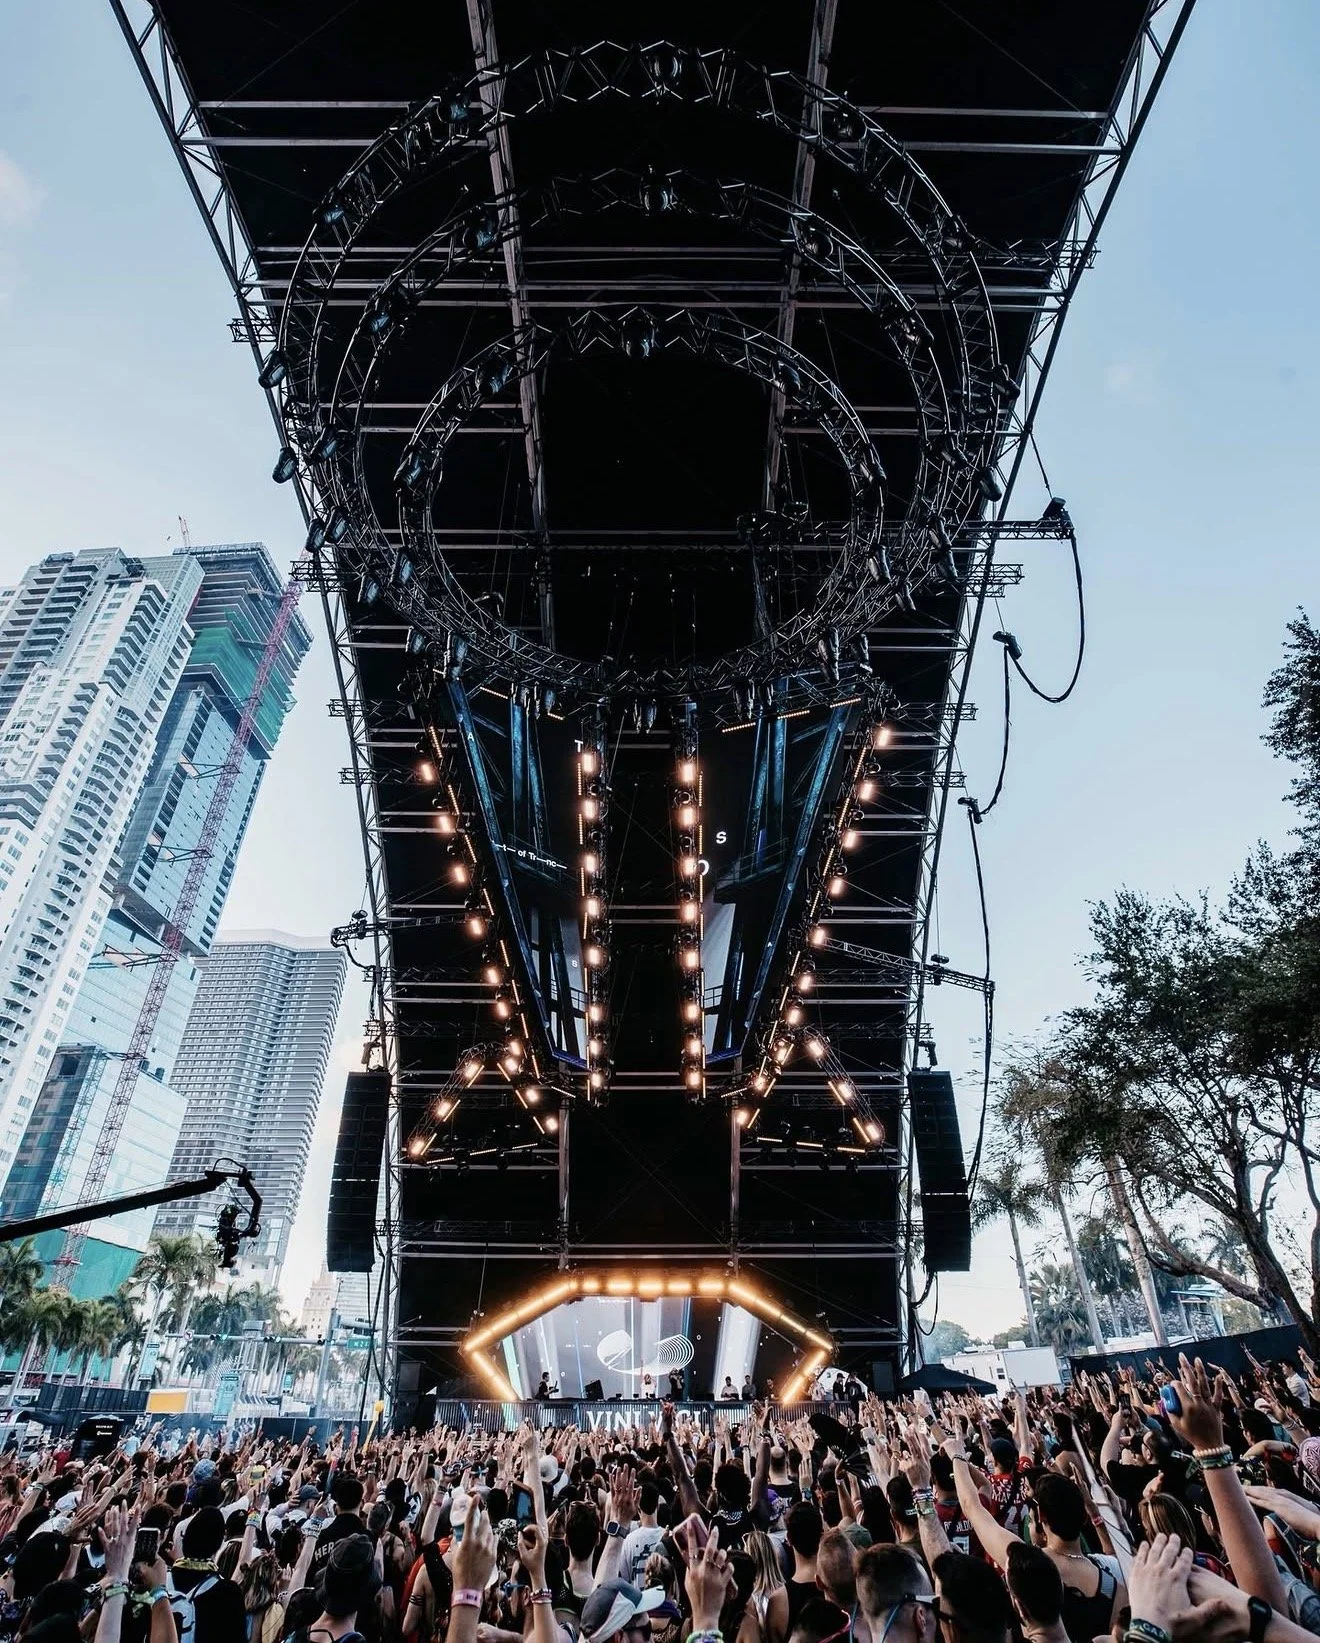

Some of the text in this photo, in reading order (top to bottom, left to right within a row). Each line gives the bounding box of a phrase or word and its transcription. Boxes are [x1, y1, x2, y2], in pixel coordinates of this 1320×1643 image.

[574, 739, 584, 753] T
[715, 830, 728, 845] S
[517, 849, 526, 858] of
[586, 1410, 641, 1433] VINI
